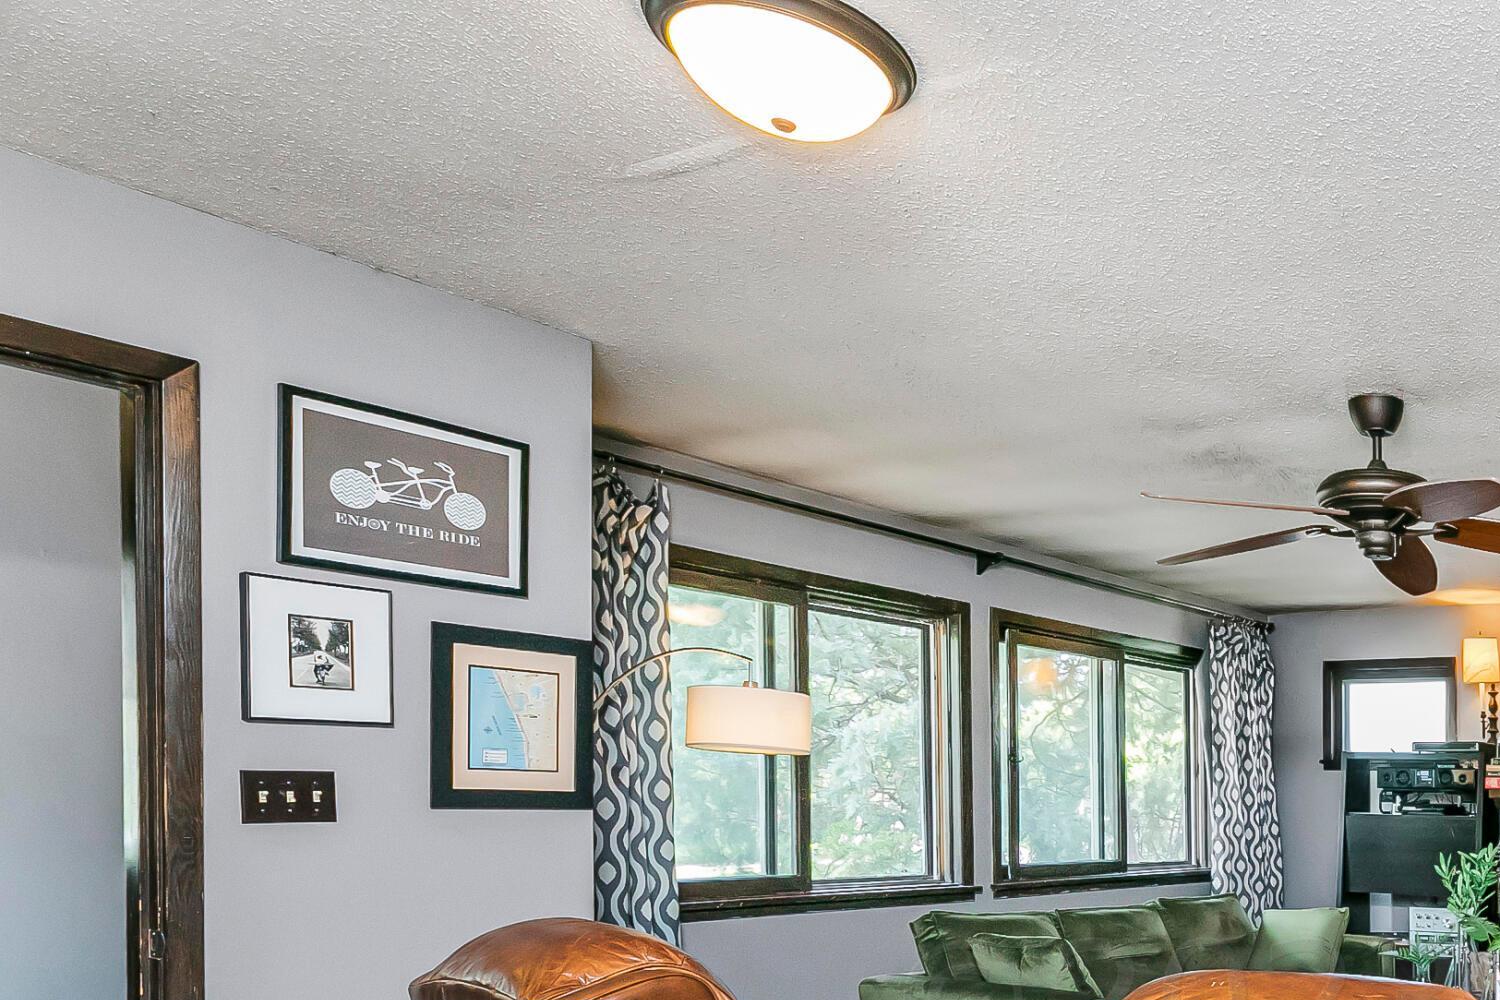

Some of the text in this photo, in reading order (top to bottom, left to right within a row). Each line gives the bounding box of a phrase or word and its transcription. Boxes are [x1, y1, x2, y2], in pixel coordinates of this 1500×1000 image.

[334, 511, 481, 547] ENJOY THE RIDE
